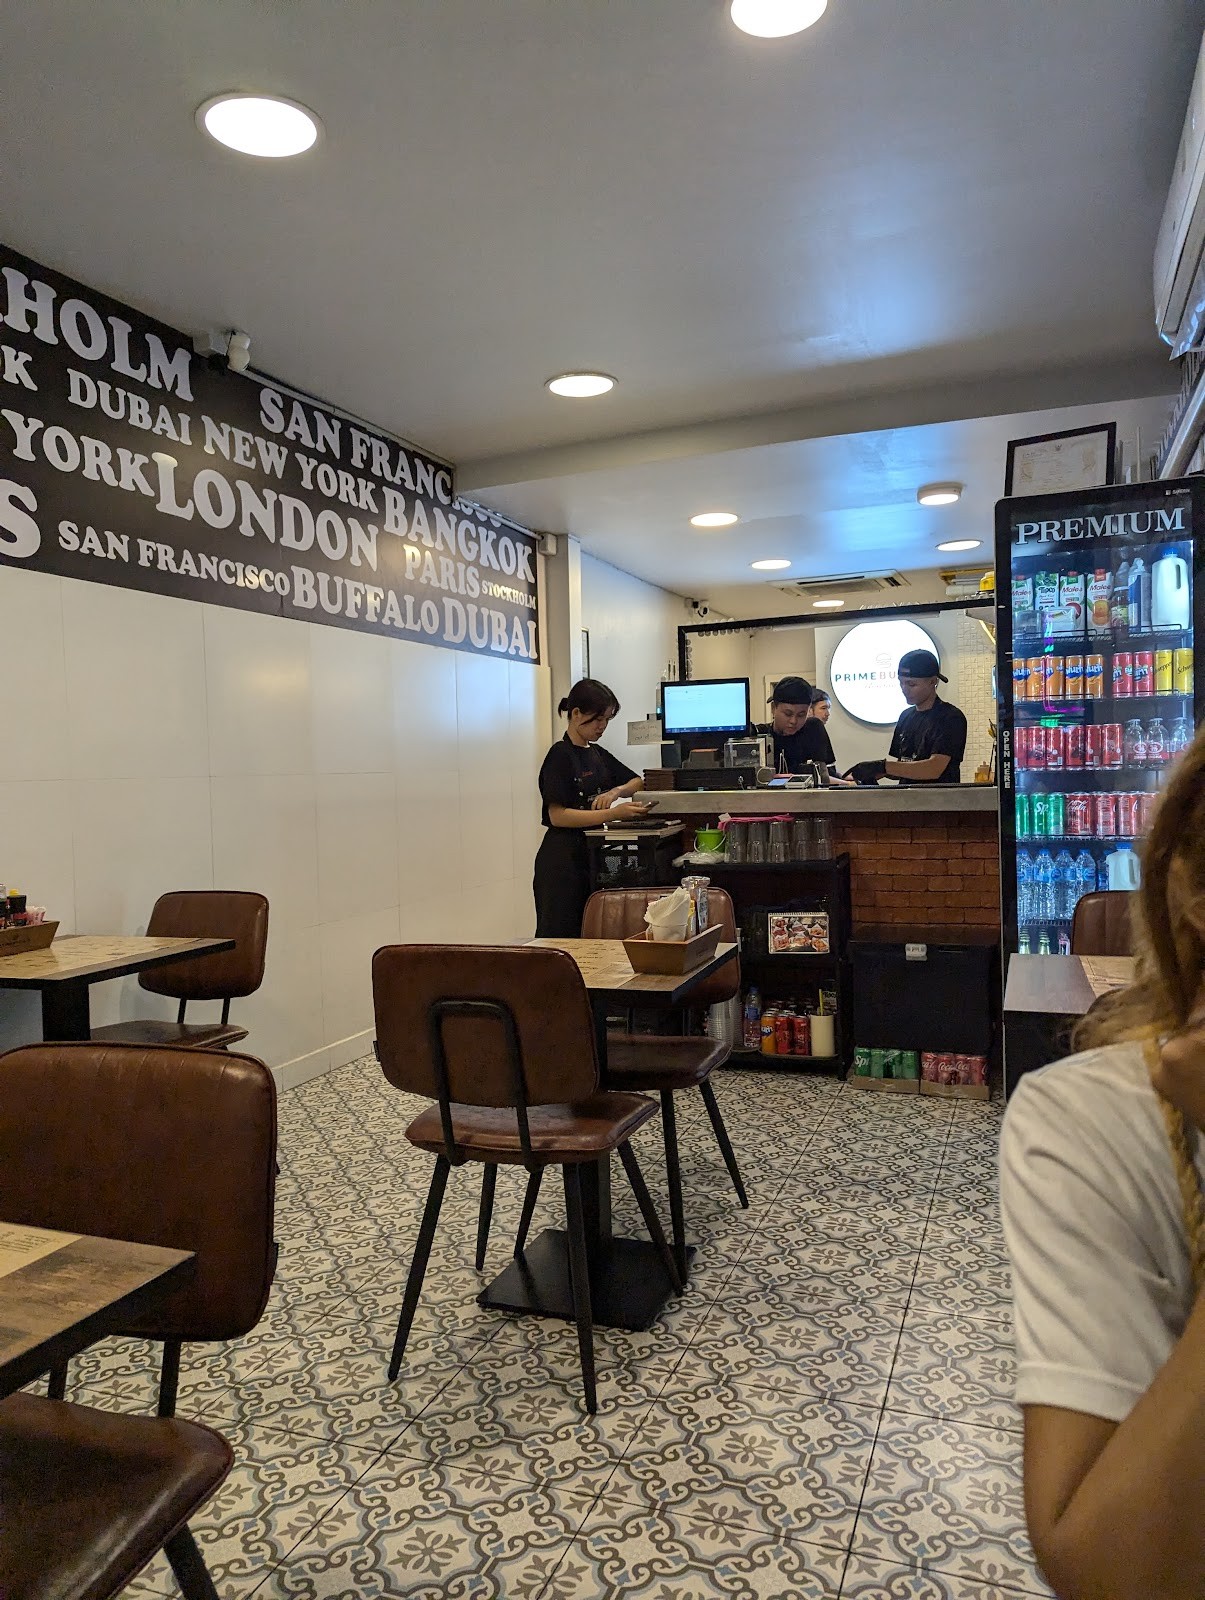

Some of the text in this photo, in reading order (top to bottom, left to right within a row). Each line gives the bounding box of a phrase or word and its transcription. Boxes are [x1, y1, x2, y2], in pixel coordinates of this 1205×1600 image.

[0, 266, 194, 402] HOLM
[259, 387, 341, 461] SAN
[0, 344, 535, 584] K DUBAI NEW YORK BANGKOK
[2, 408, 536, 610] YORK LONDON PARIS STOCKHOLM
[1015, 507, 1186, 546] PREMIUM
[57, 520, 130, 563] SAN
[137, 537, 291, 597] FRANCISCO
[290, 564, 440, 635] BUFFALO
[442, 596, 538, 660] DUBAI
[835, 671, 896, 683] PRIMEBU
[1002, 730, 1011, 789] OPEN HERE
